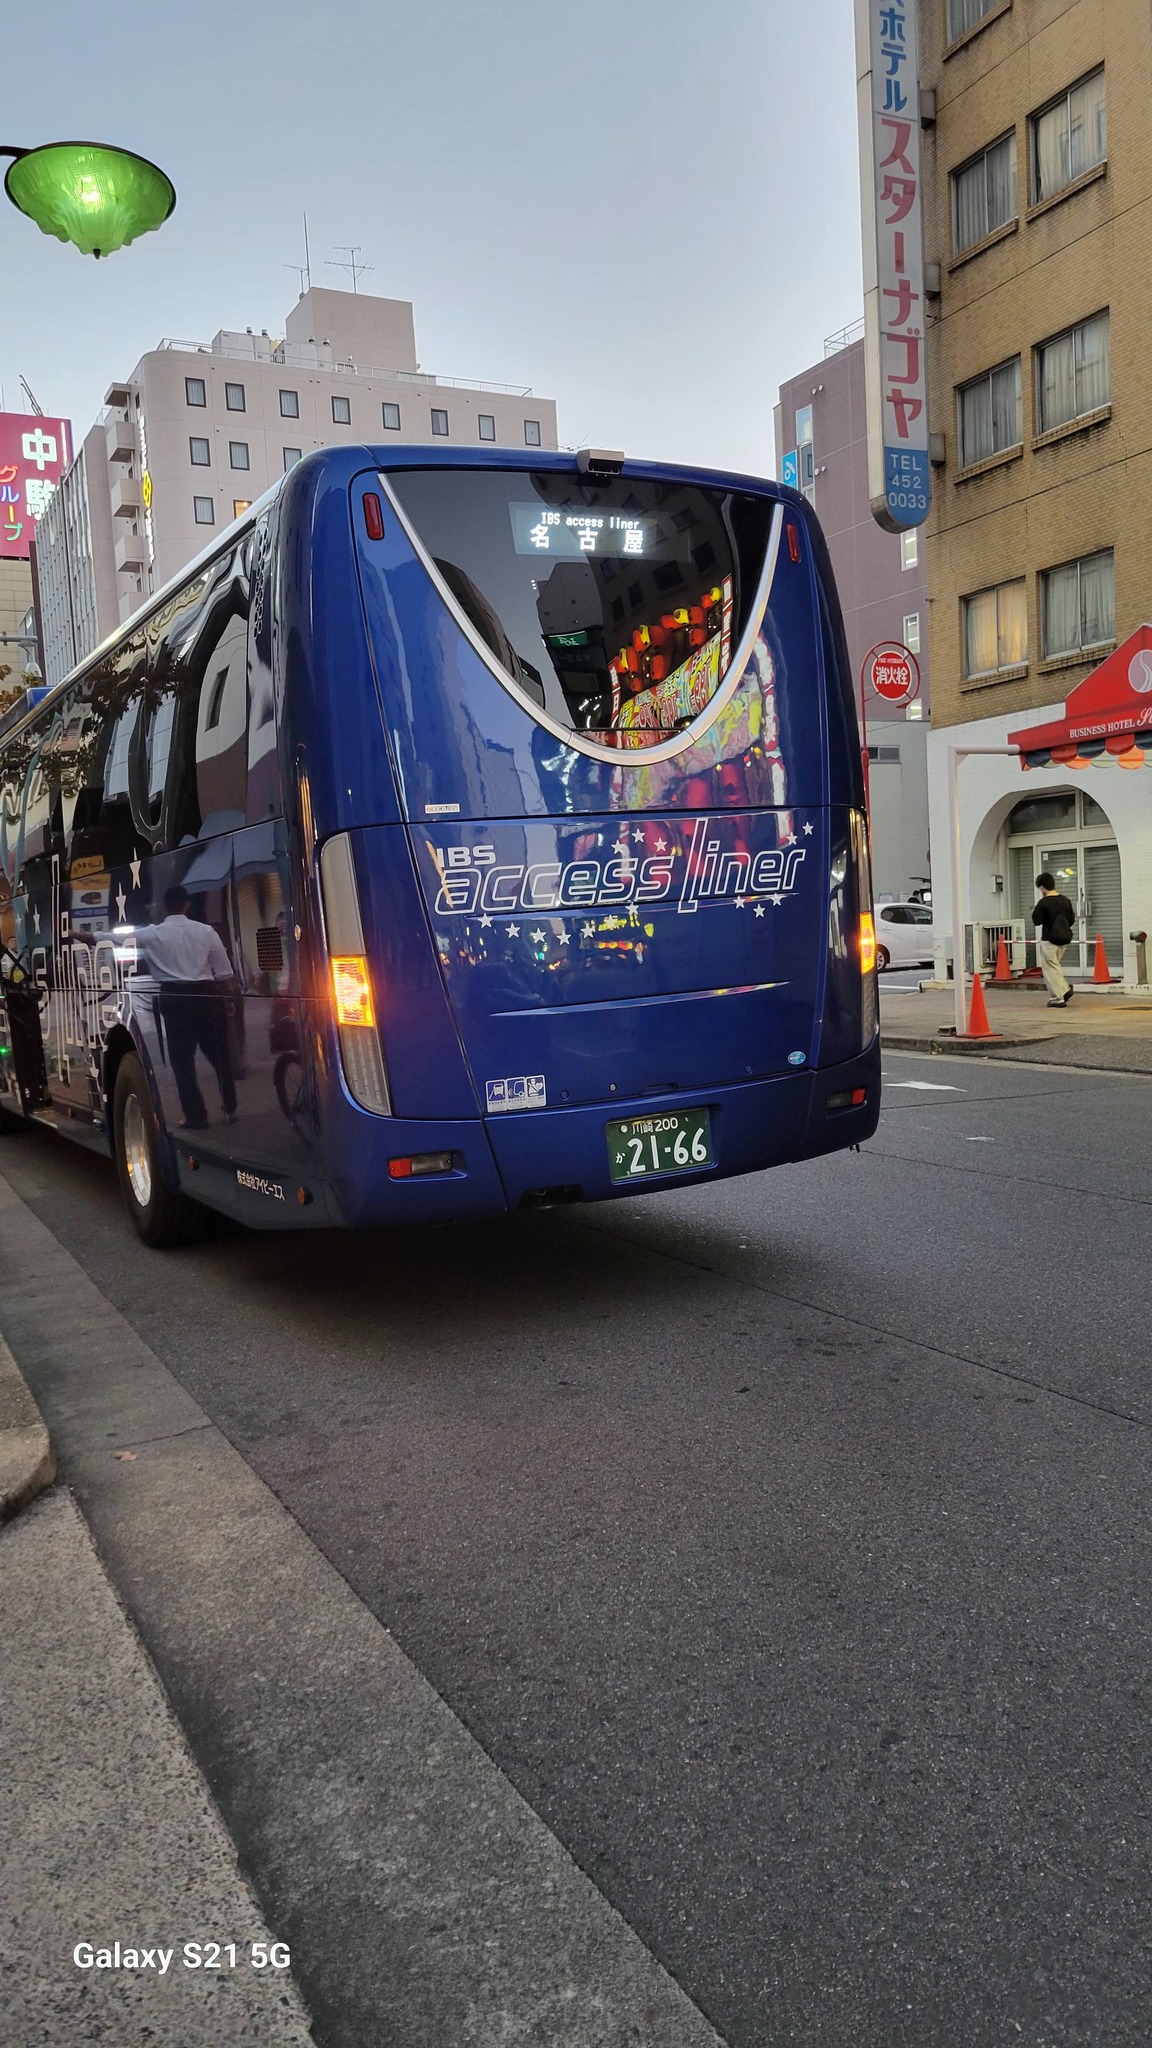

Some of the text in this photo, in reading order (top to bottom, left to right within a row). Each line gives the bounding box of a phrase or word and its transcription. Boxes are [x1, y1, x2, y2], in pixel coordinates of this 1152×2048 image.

[879, 0, 908, 113] ホテル
[879, 118, 923, 438] スターナゴヤ
[890, 454, 922, 471] TEL
[891, 475, 922, 489] 452
[0, 464, 23, 541] グループ
[888, 493, 927, 509] 0033
[541, 512, 640, 530] IBS access liner
[530, 524, 643, 553] 名古屋
[875, 666, 909, 685] 消火栓
[1069, 724, 1106, 738] BUSINESS
[1108, 718, 1135, 732] HOTEL
[434, 817, 807, 915] access liner
[437, 844, 497, 868] IBS
[615, 1127, 707, 1174] か 21-66
